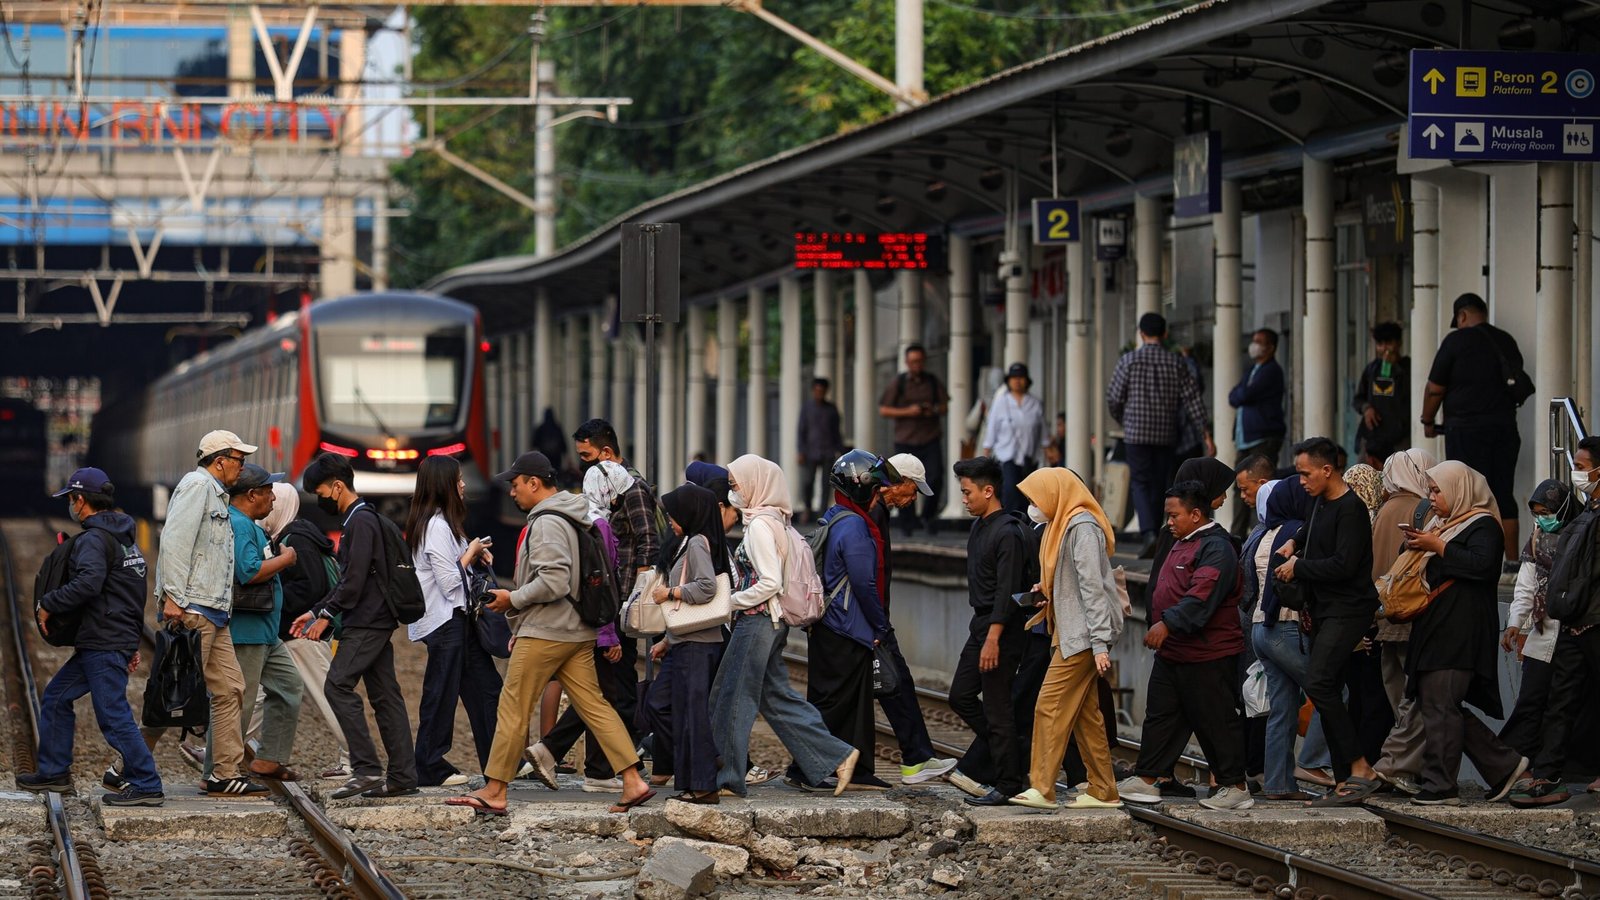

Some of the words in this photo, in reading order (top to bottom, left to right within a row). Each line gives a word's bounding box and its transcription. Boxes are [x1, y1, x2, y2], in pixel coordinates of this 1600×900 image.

[1493, 70, 1535, 84] Peron
[1540, 70, 1558, 94] 2
[1492, 85, 1533, 95] Platform
[1492, 125, 1544, 139] Musala
[1490, 140, 1527, 152] Praying
[1528, 141, 1556, 151] Room
[1047, 208, 1071, 239] 2
